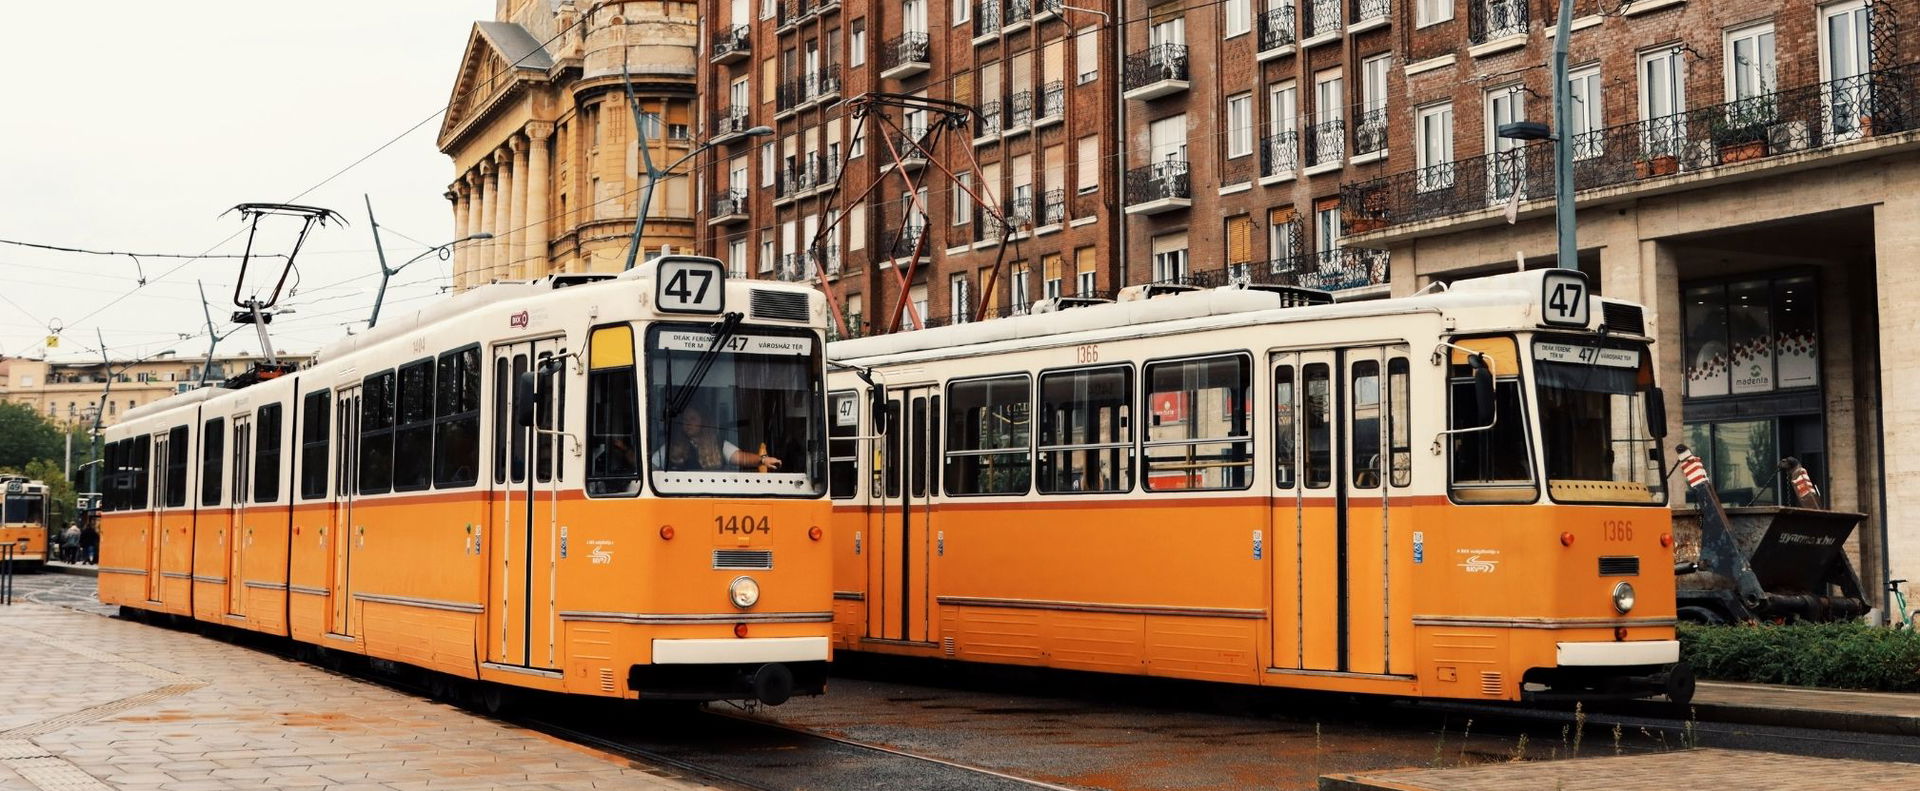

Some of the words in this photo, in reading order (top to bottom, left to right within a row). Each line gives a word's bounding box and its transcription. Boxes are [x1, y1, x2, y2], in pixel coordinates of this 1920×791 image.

[664, 269, 713, 304] 47
[1549, 283, 1582, 317] 47
[727, 337, 749, 351] 47
[758, 342, 791, 350] VÁROSHÁZ
[1076, 345, 1099, 363] 1366
[1578, 347, 1595, 362] 47
[840, 400, 852, 416] 47
[714, 515, 770, 534] 1404
[1603, 520, 1633, 541] 1366
